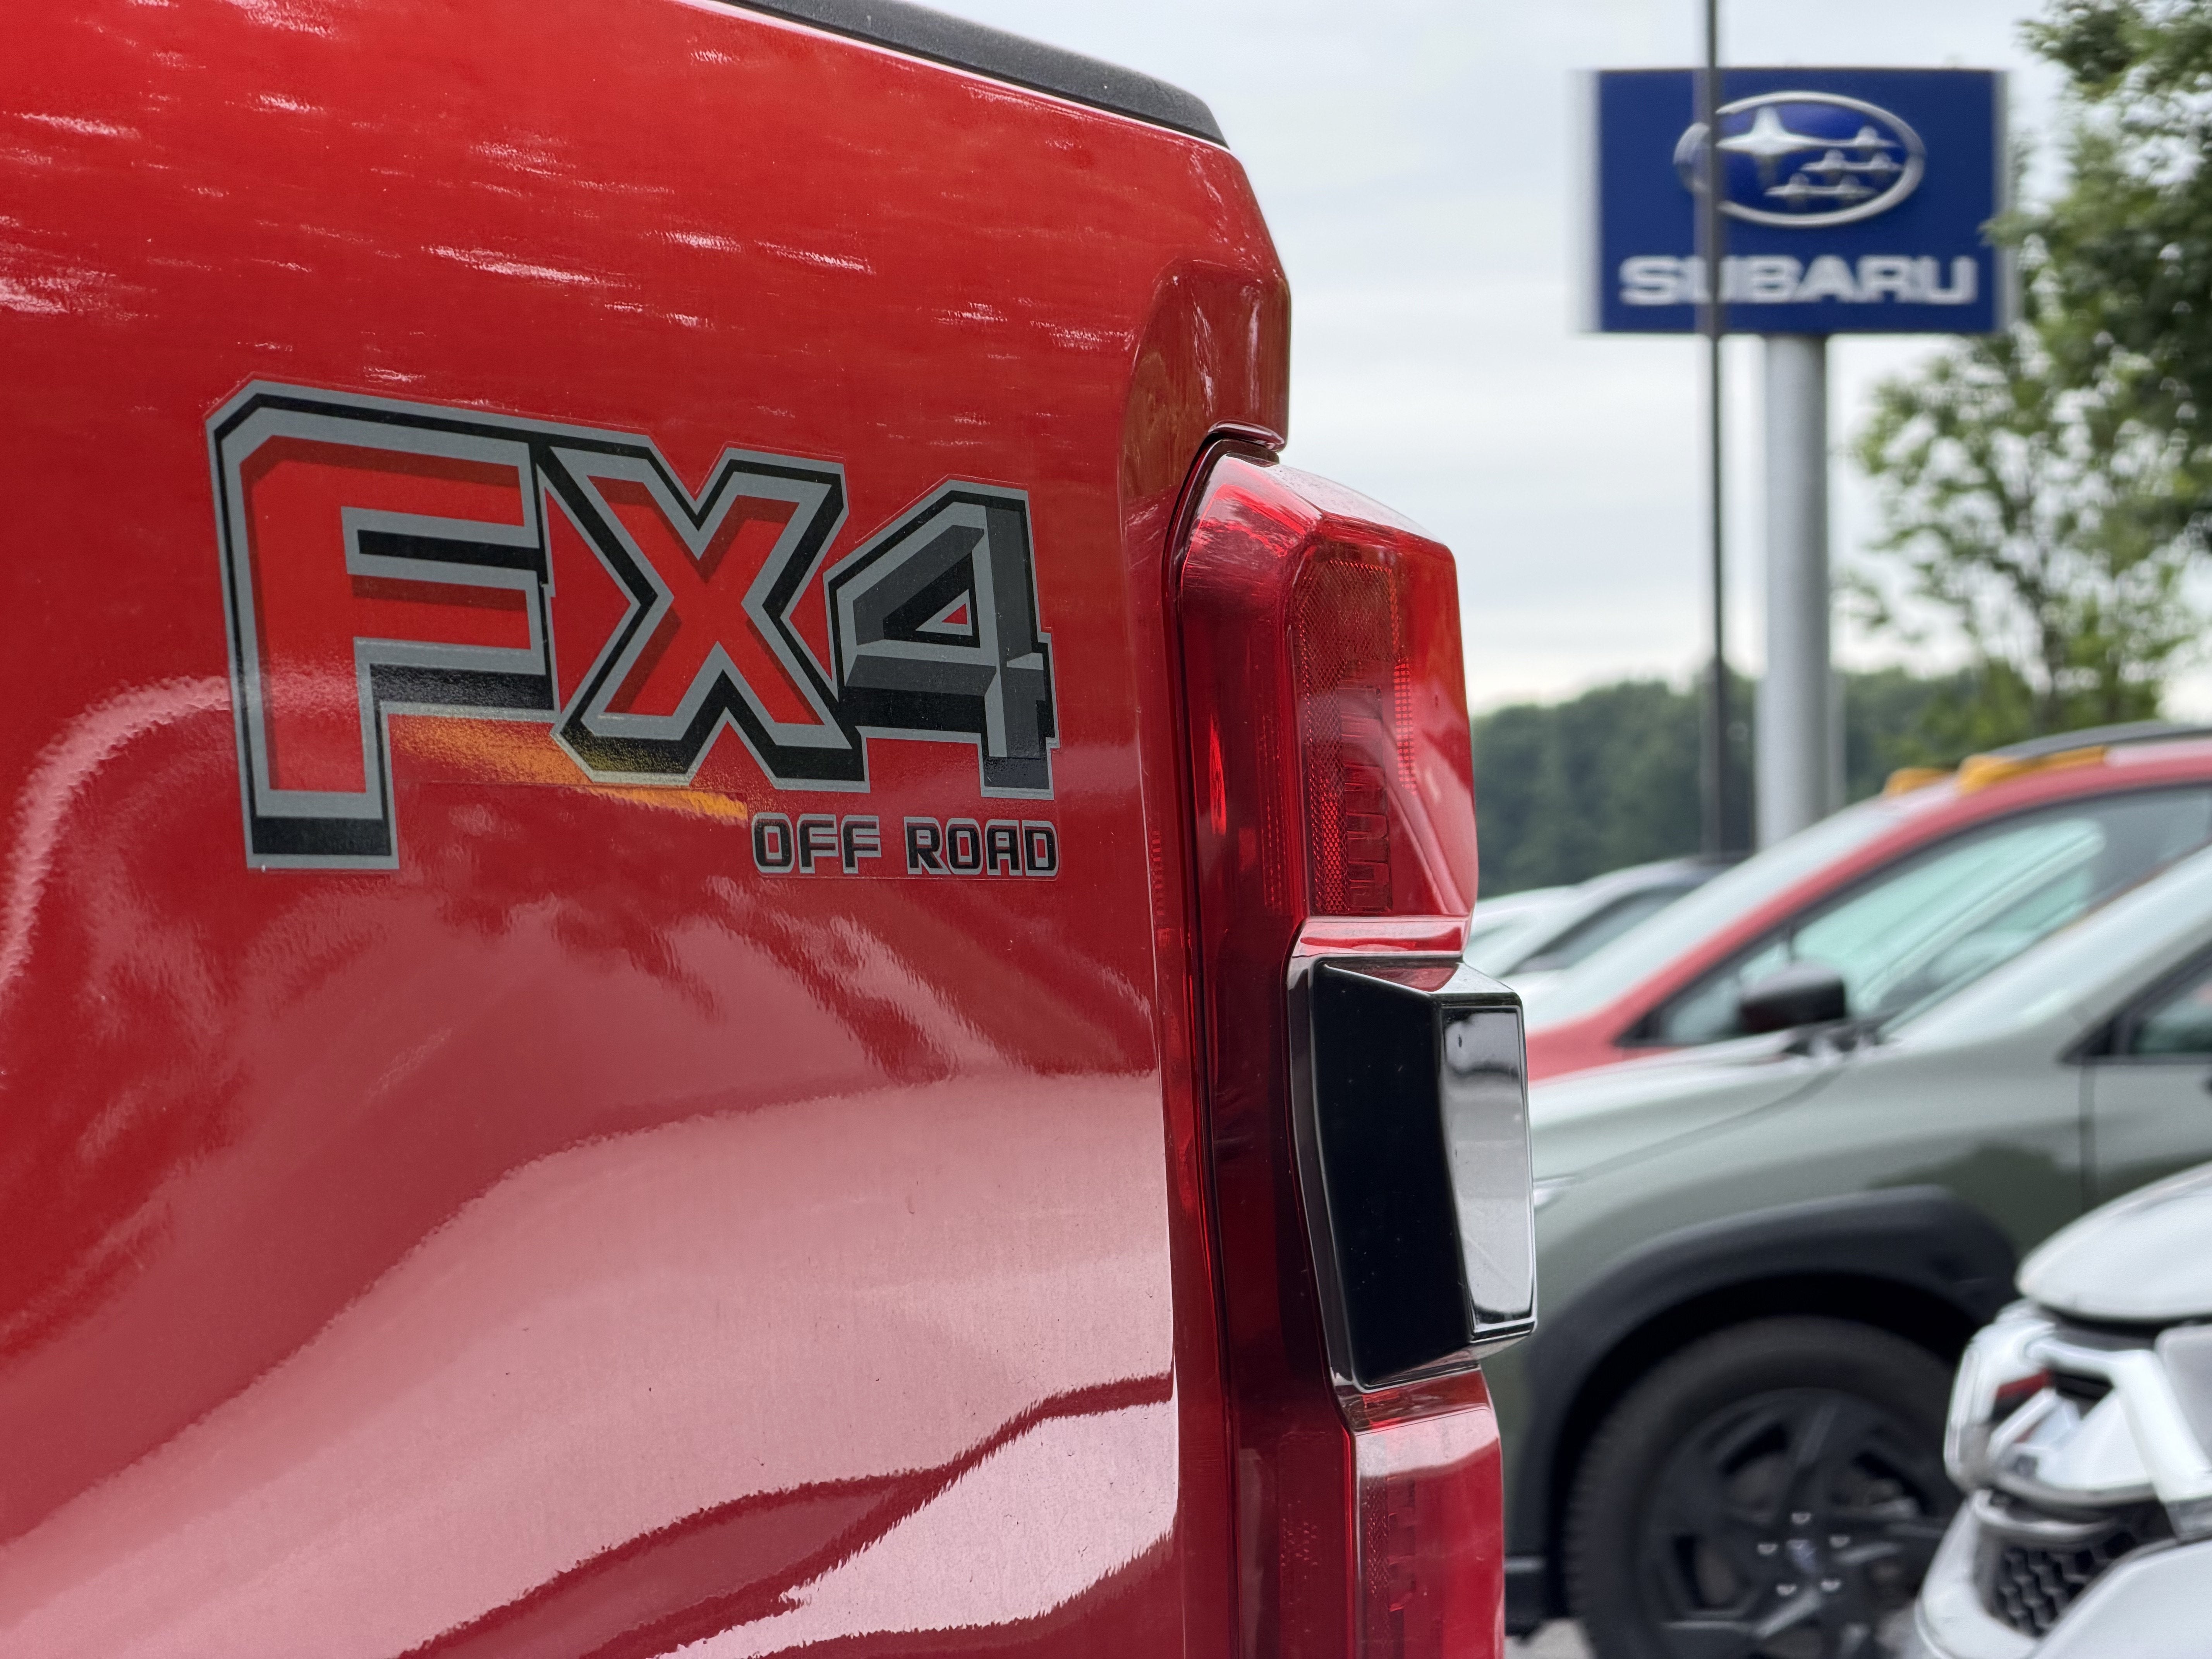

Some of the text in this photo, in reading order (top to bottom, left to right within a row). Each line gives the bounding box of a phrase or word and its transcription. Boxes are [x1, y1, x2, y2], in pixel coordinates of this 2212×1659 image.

[1620, 255, 1977, 305] SUBARU
[205, 379, 1059, 870] FX4
[751, 812, 1060, 876] OFF ROAD
